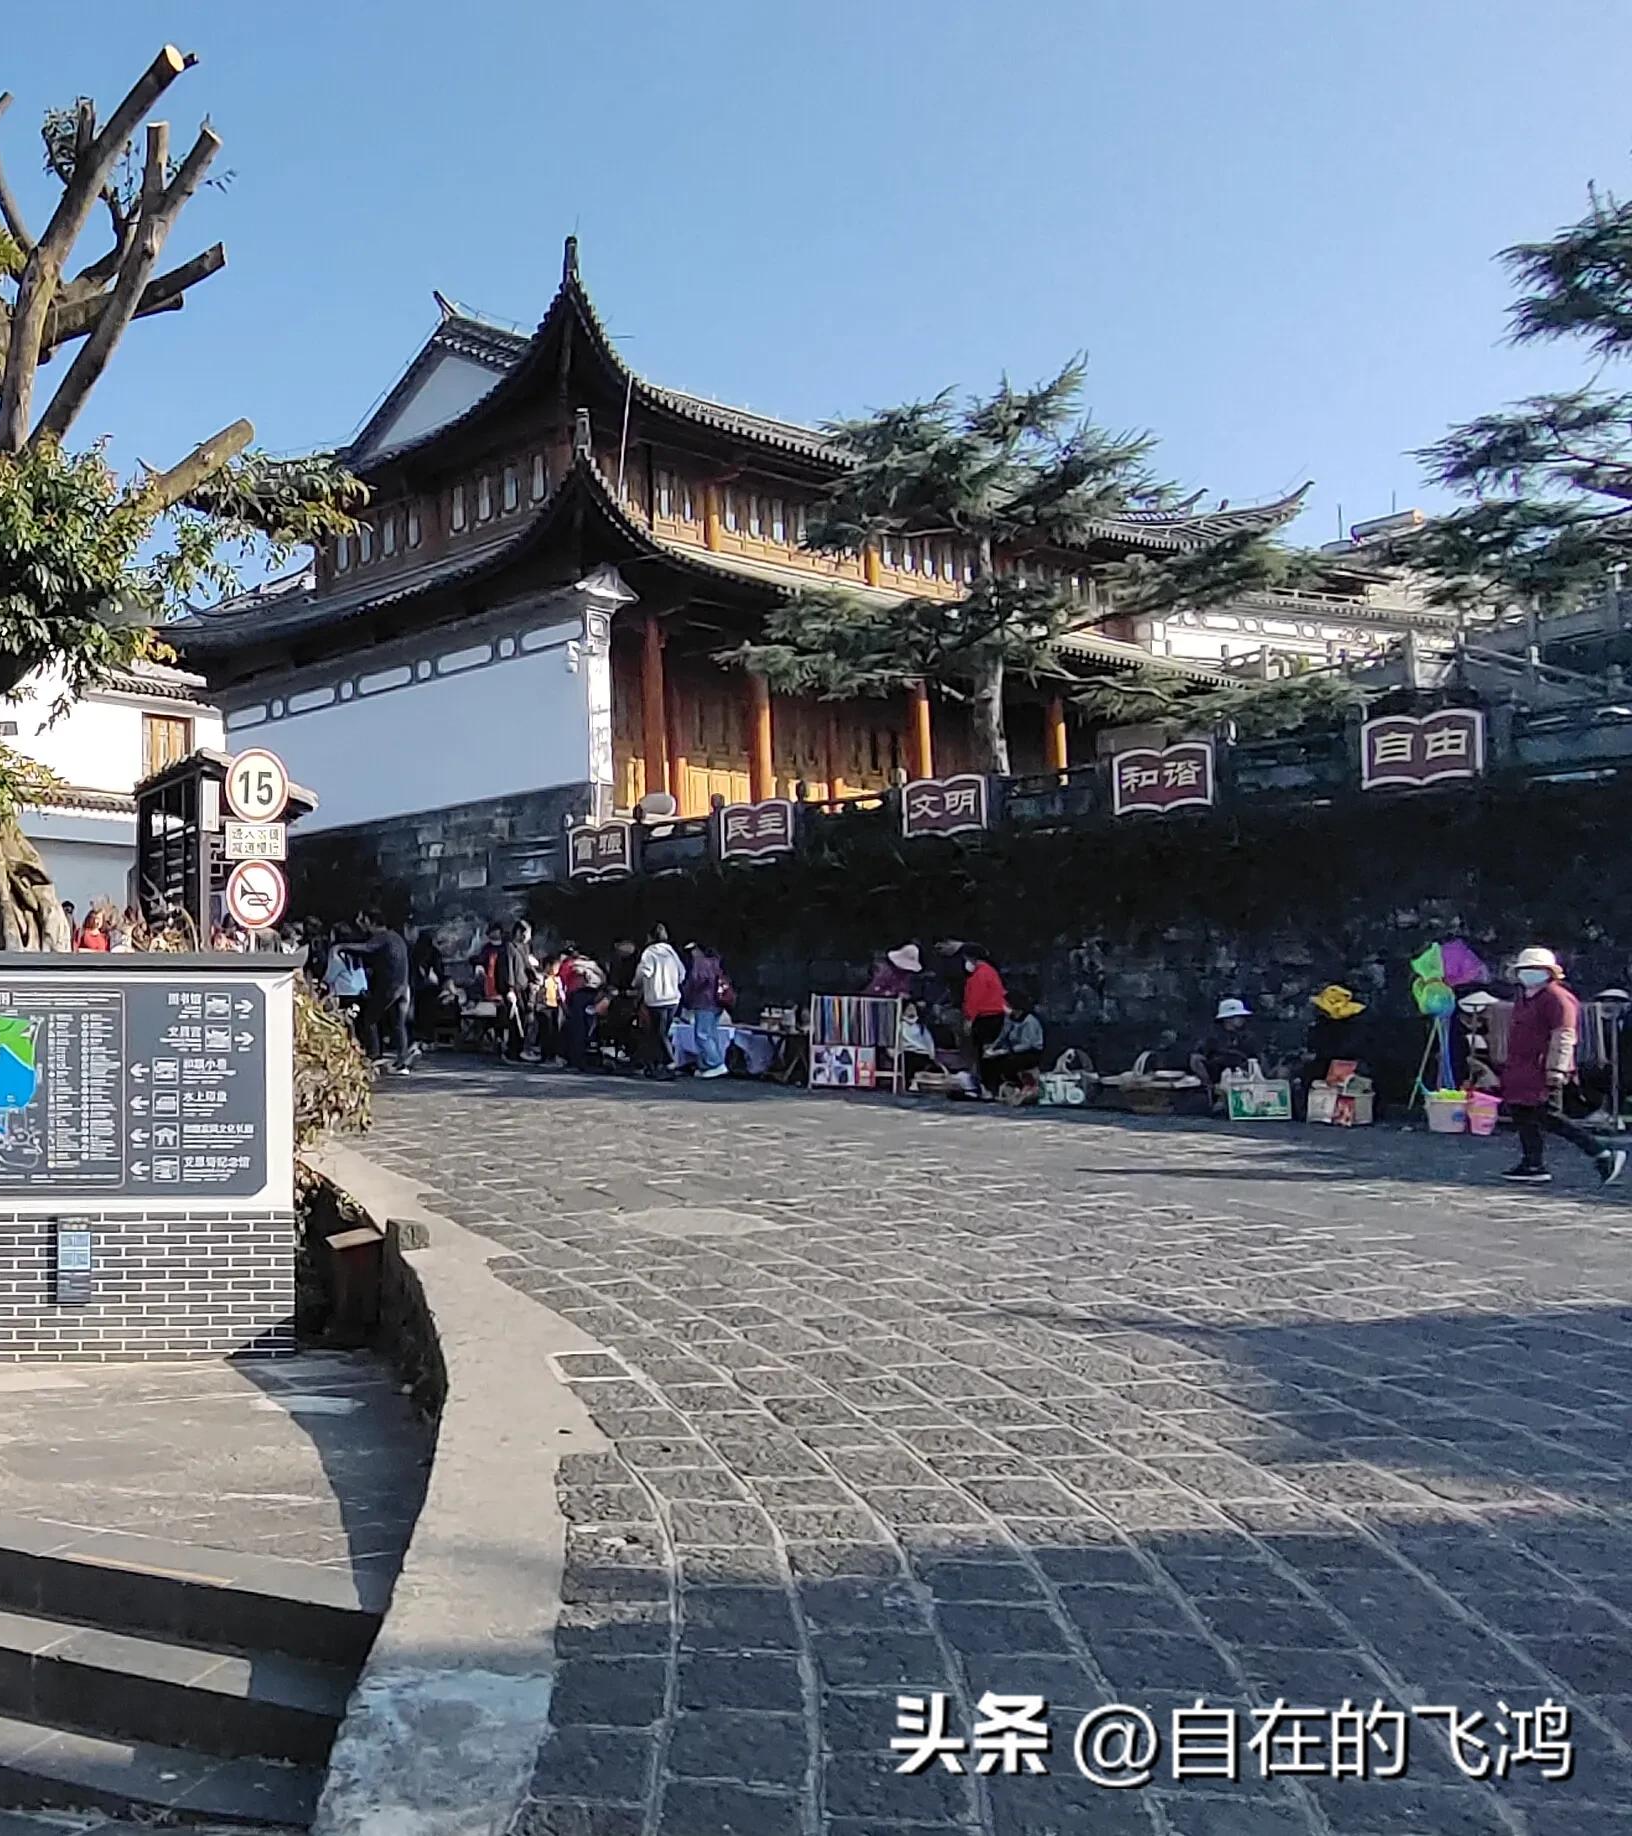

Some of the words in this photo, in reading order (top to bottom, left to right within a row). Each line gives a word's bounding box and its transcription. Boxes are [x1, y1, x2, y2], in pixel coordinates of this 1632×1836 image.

[1374, 727, 1468, 766] 自由
[238, 770, 273, 805] 15
[1121, 760, 1203, 793] 和谐
[910, 788, 977, 819] 文明
[726, 812, 786, 841] 民主
